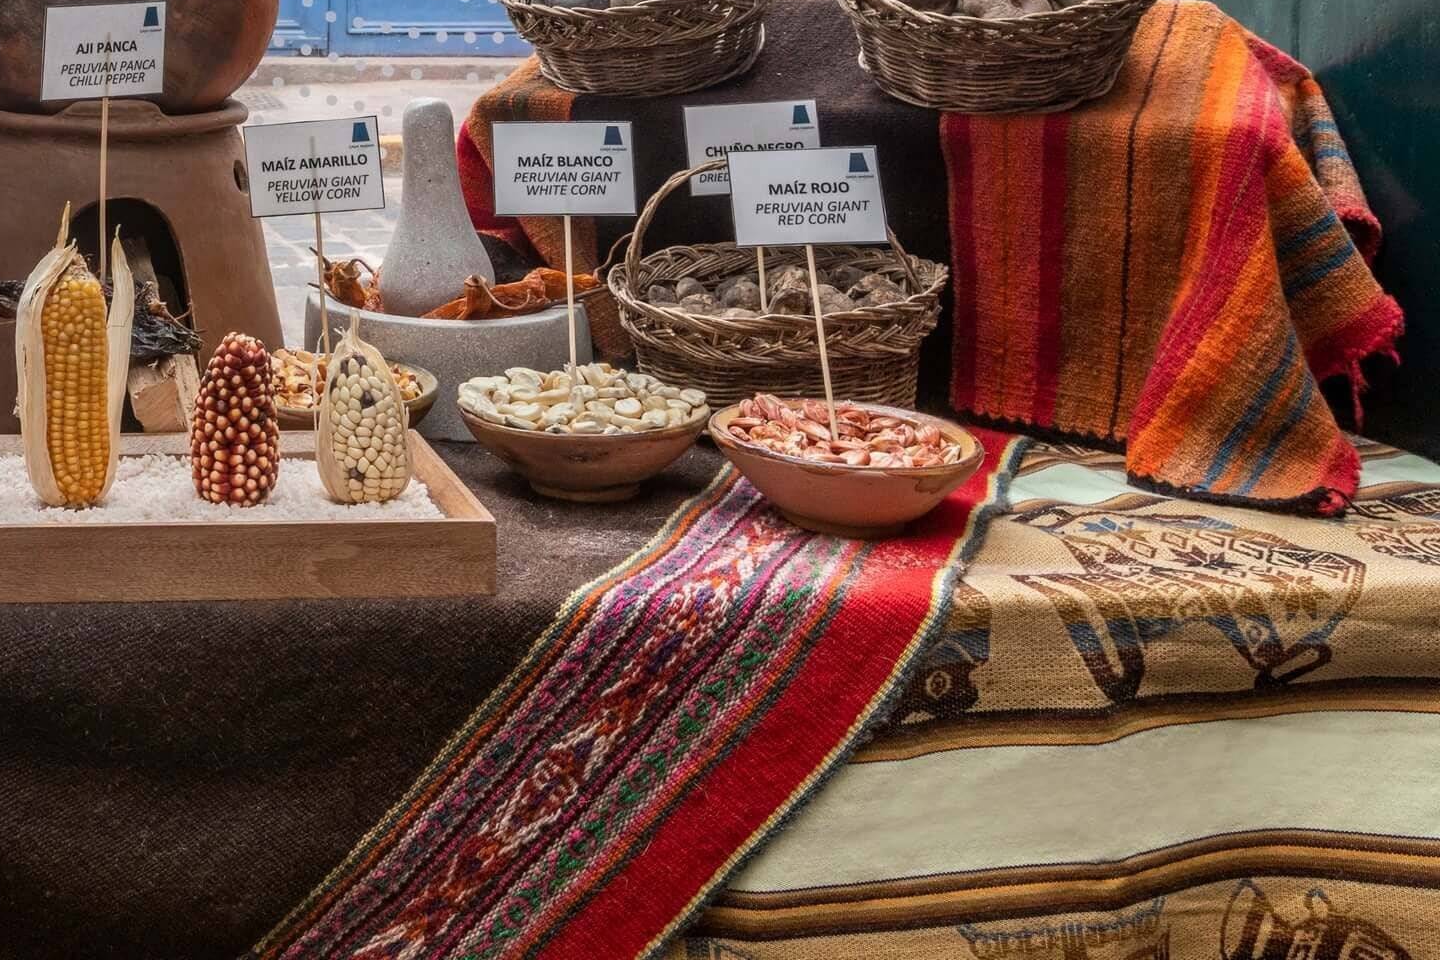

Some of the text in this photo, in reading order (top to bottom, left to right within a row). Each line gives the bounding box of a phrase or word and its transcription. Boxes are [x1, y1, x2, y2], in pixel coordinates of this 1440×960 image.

[76, 40, 137, 55] AJI PANCA
[61, 59, 155, 75] PERUVIAN PANCA
[69, 72, 145, 86] CHILLI PEPPER
[262, 154, 367, 172] MAÍZ AMARILLO
[518, 153, 612, 167] MAÍZ BLANCO
[268, 175, 369, 191] PERUVIAN GIANT
[514, 172, 621, 182] PERUVIAN GIANT
[527, 185, 606, 195] WHITE CORN
[769, 181, 849, 195] MAÍZ ROJO
[276, 188, 360, 203] YELLOW CORN
[756, 200, 870, 214] PERUVIAN GIANT
[778, 213, 846, 226] RED CORN
